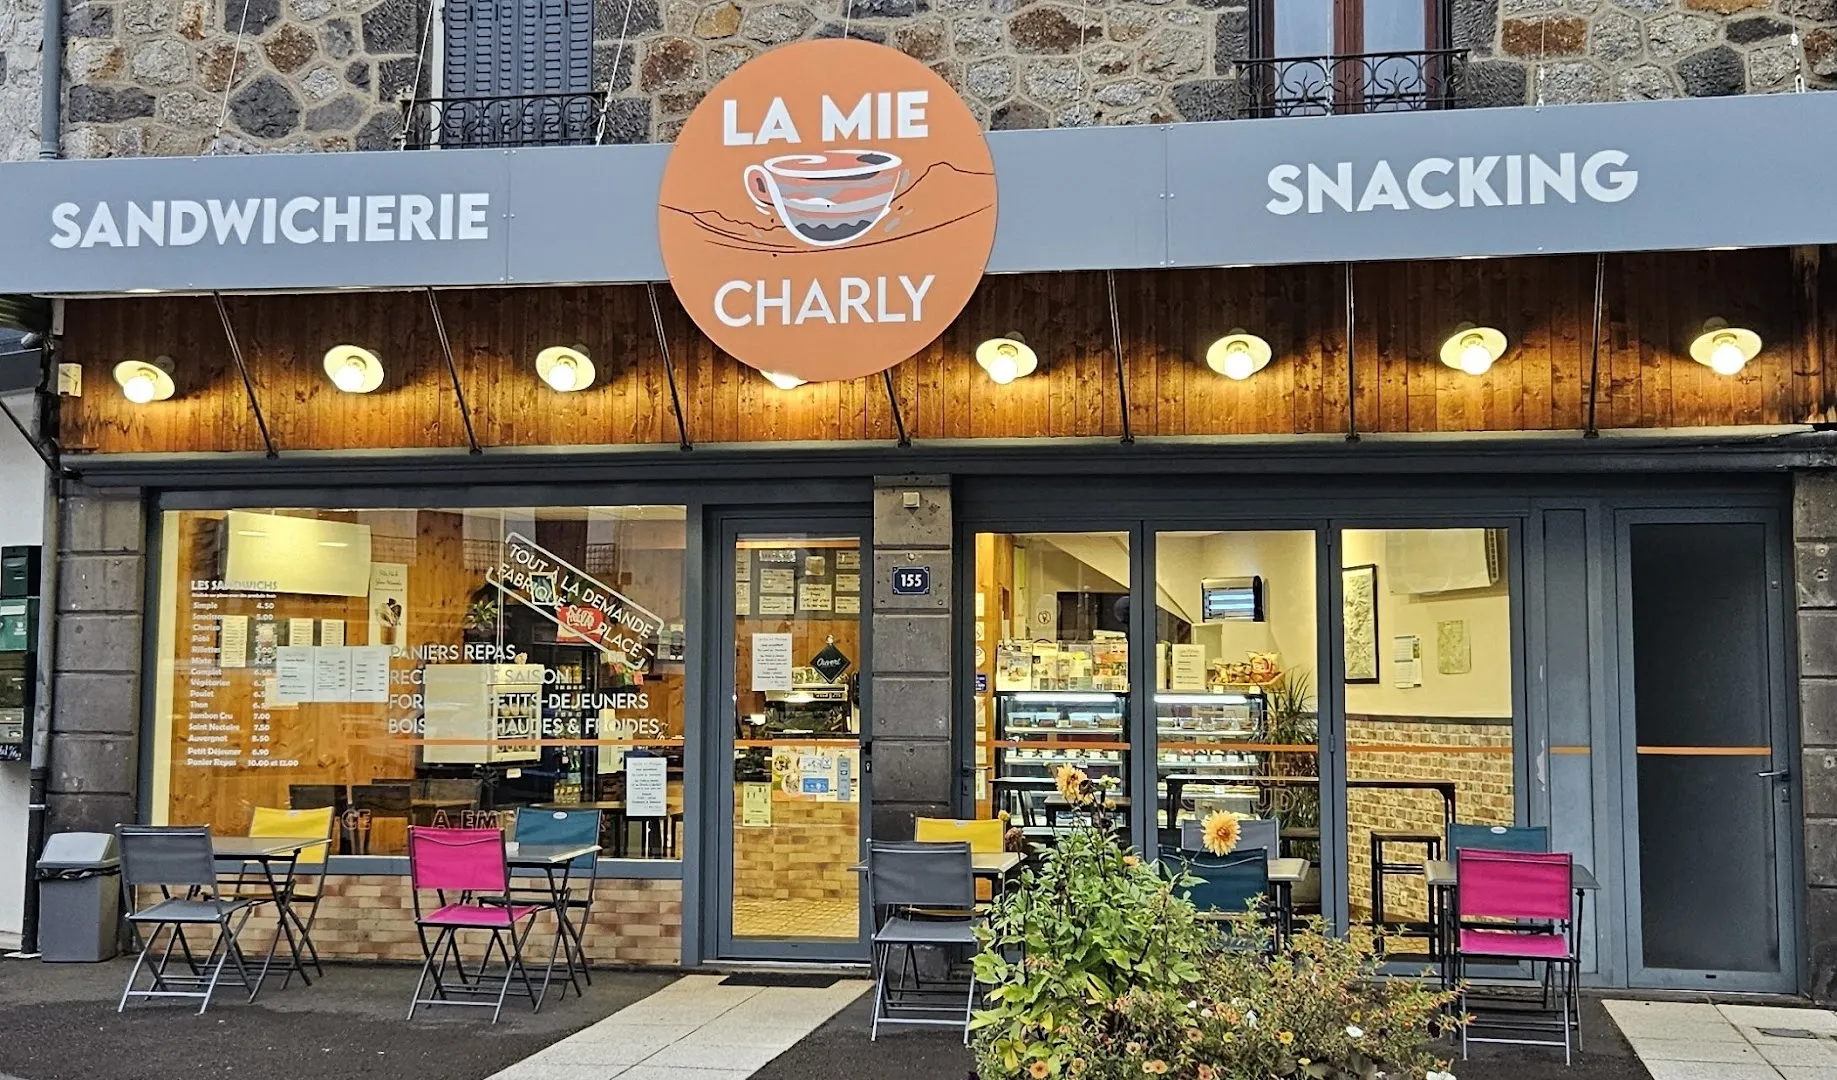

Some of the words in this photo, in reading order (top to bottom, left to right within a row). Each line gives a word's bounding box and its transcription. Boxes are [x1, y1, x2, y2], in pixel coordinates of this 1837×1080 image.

[723, 96, 802, 146] LA
[822, 90, 929, 142] MIE
[1266, 149, 1639, 216] SNACKING
[49, 192, 490, 249] SANDWICHERIE
[714, 274, 936, 328] CHARLY
[901, 573, 922, 587] 155
[191, 580, 210, 590] LES
[211, 580, 278, 591] SANDWICHS
[509, 543, 549, 573] TOUT
[561, 575, 580, 597] LA
[582, 588, 654, 640] DEMANDE
[193, 601, 218, 611] Simple
[256, 602, 275, 610] 4.50
[390, 644, 460, 661] PANIERS
[464, 643, 516, 661] REPAS
[191, 656, 212, 664] Mixte
[816, 657, 841, 667] Ouvert
[191, 668, 222, 676] Complet
[505, 668, 569, 685] SAISON
[190, 690, 214, 698] Poulet
[190, 701, 209, 709] Thon
[189, 712, 218, 720] Jambon
[219, 712, 233, 720] Cru
[188, 723, 208, 731] Saint
[568, 718, 581, 735] &
[584, 718, 659, 736] FROIDES
[187, 747, 207, 755] Petit
[207, 747, 242, 756] Déjeuner
[187, 758, 212, 766] Panier
[213, 759, 237, 767] Repas
